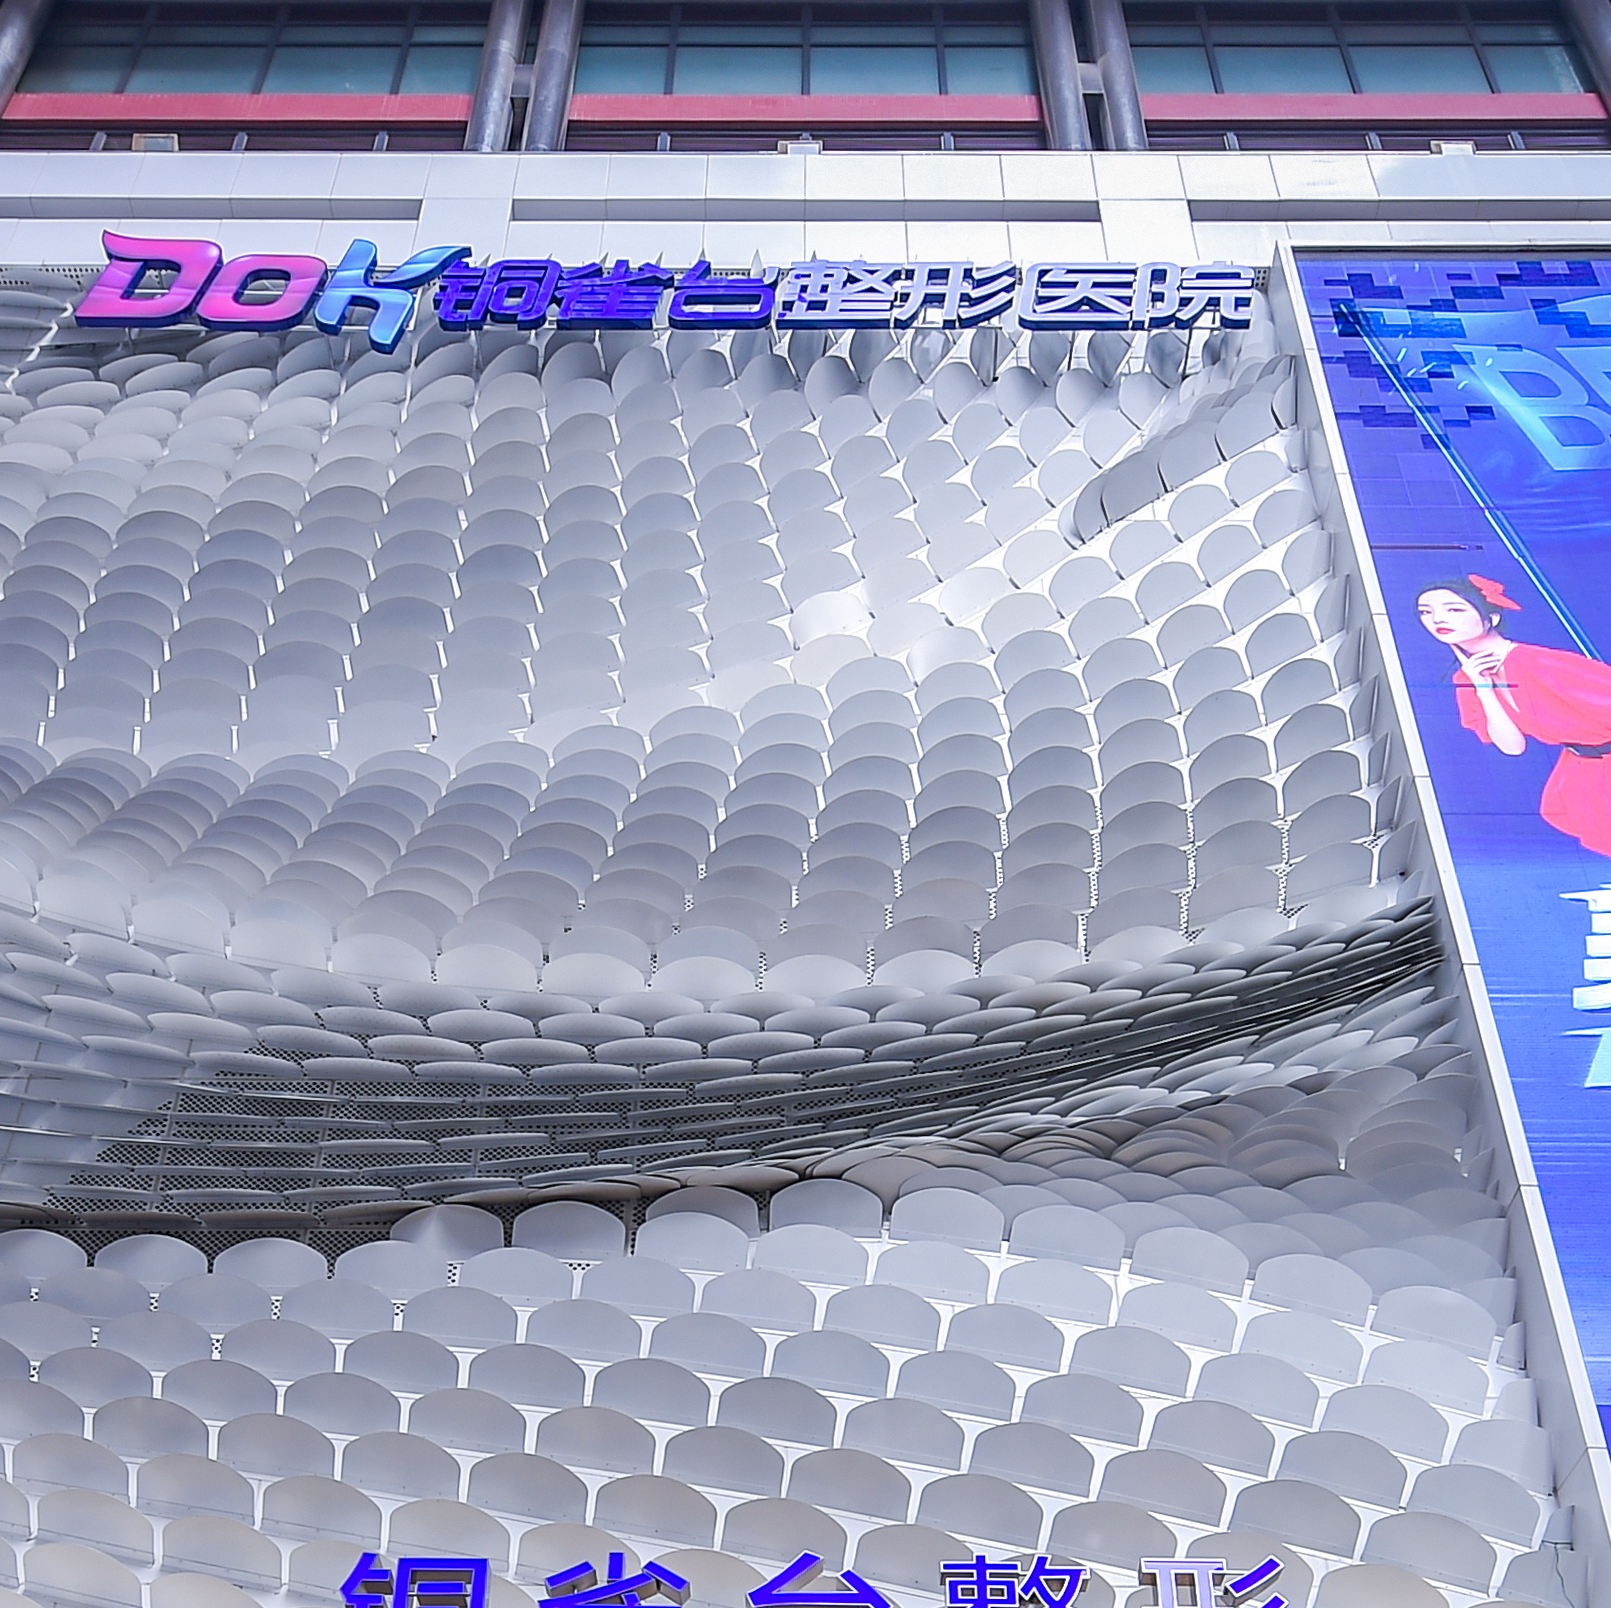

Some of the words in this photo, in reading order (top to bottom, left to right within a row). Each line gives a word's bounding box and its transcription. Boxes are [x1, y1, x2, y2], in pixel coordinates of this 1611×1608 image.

[432, 256, 1255, 333] 铜雀台整形医院
